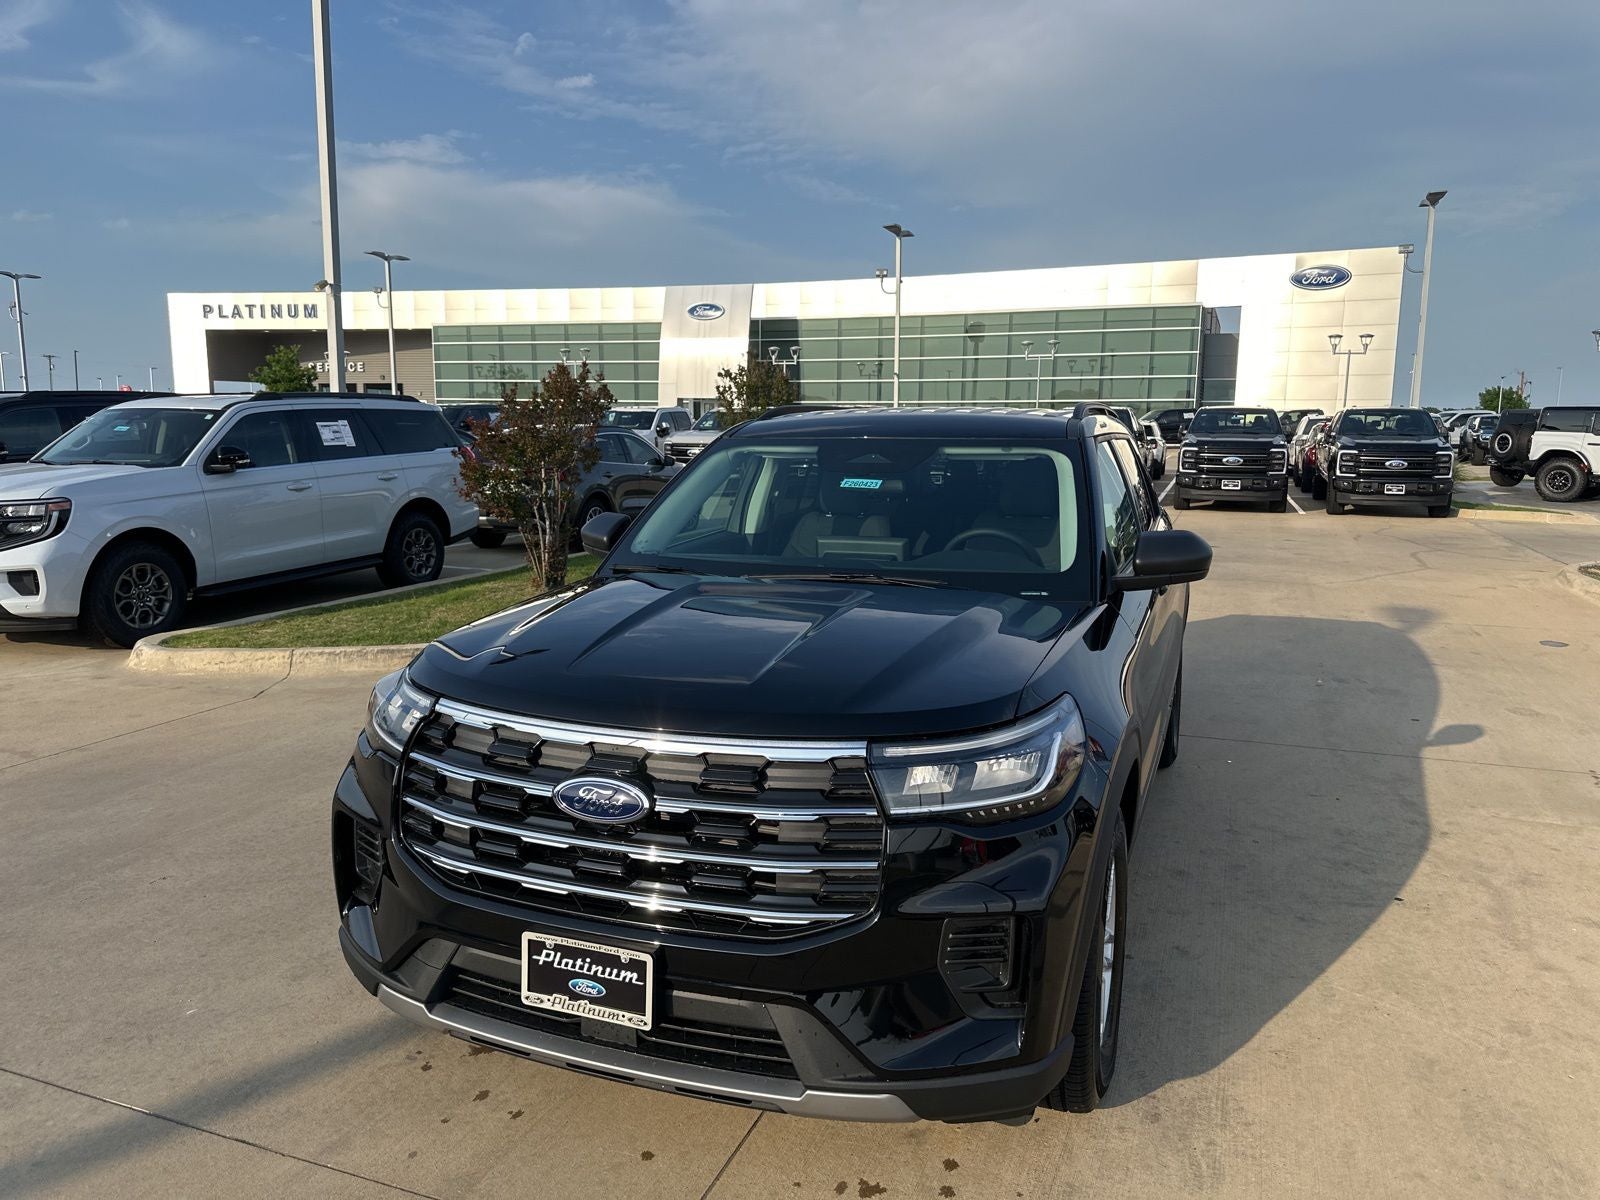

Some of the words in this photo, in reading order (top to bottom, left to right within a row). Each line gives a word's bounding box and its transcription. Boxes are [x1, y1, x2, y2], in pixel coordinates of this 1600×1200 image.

[1302, 270, 1338, 285] Ford
[202, 303, 319, 319] PLATINUM
[308, 361, 364, 372] SERCE
[843, 480, 880, 488] F260423
[572, 786, 623, 815] Ford
[535, 935, 641, 959] www.PlatinumFord.com
[532, 949, 644, 985] Platinum
[575, 980, 599, 996] Ford
[551, 995, 620, 1021] Platinum
